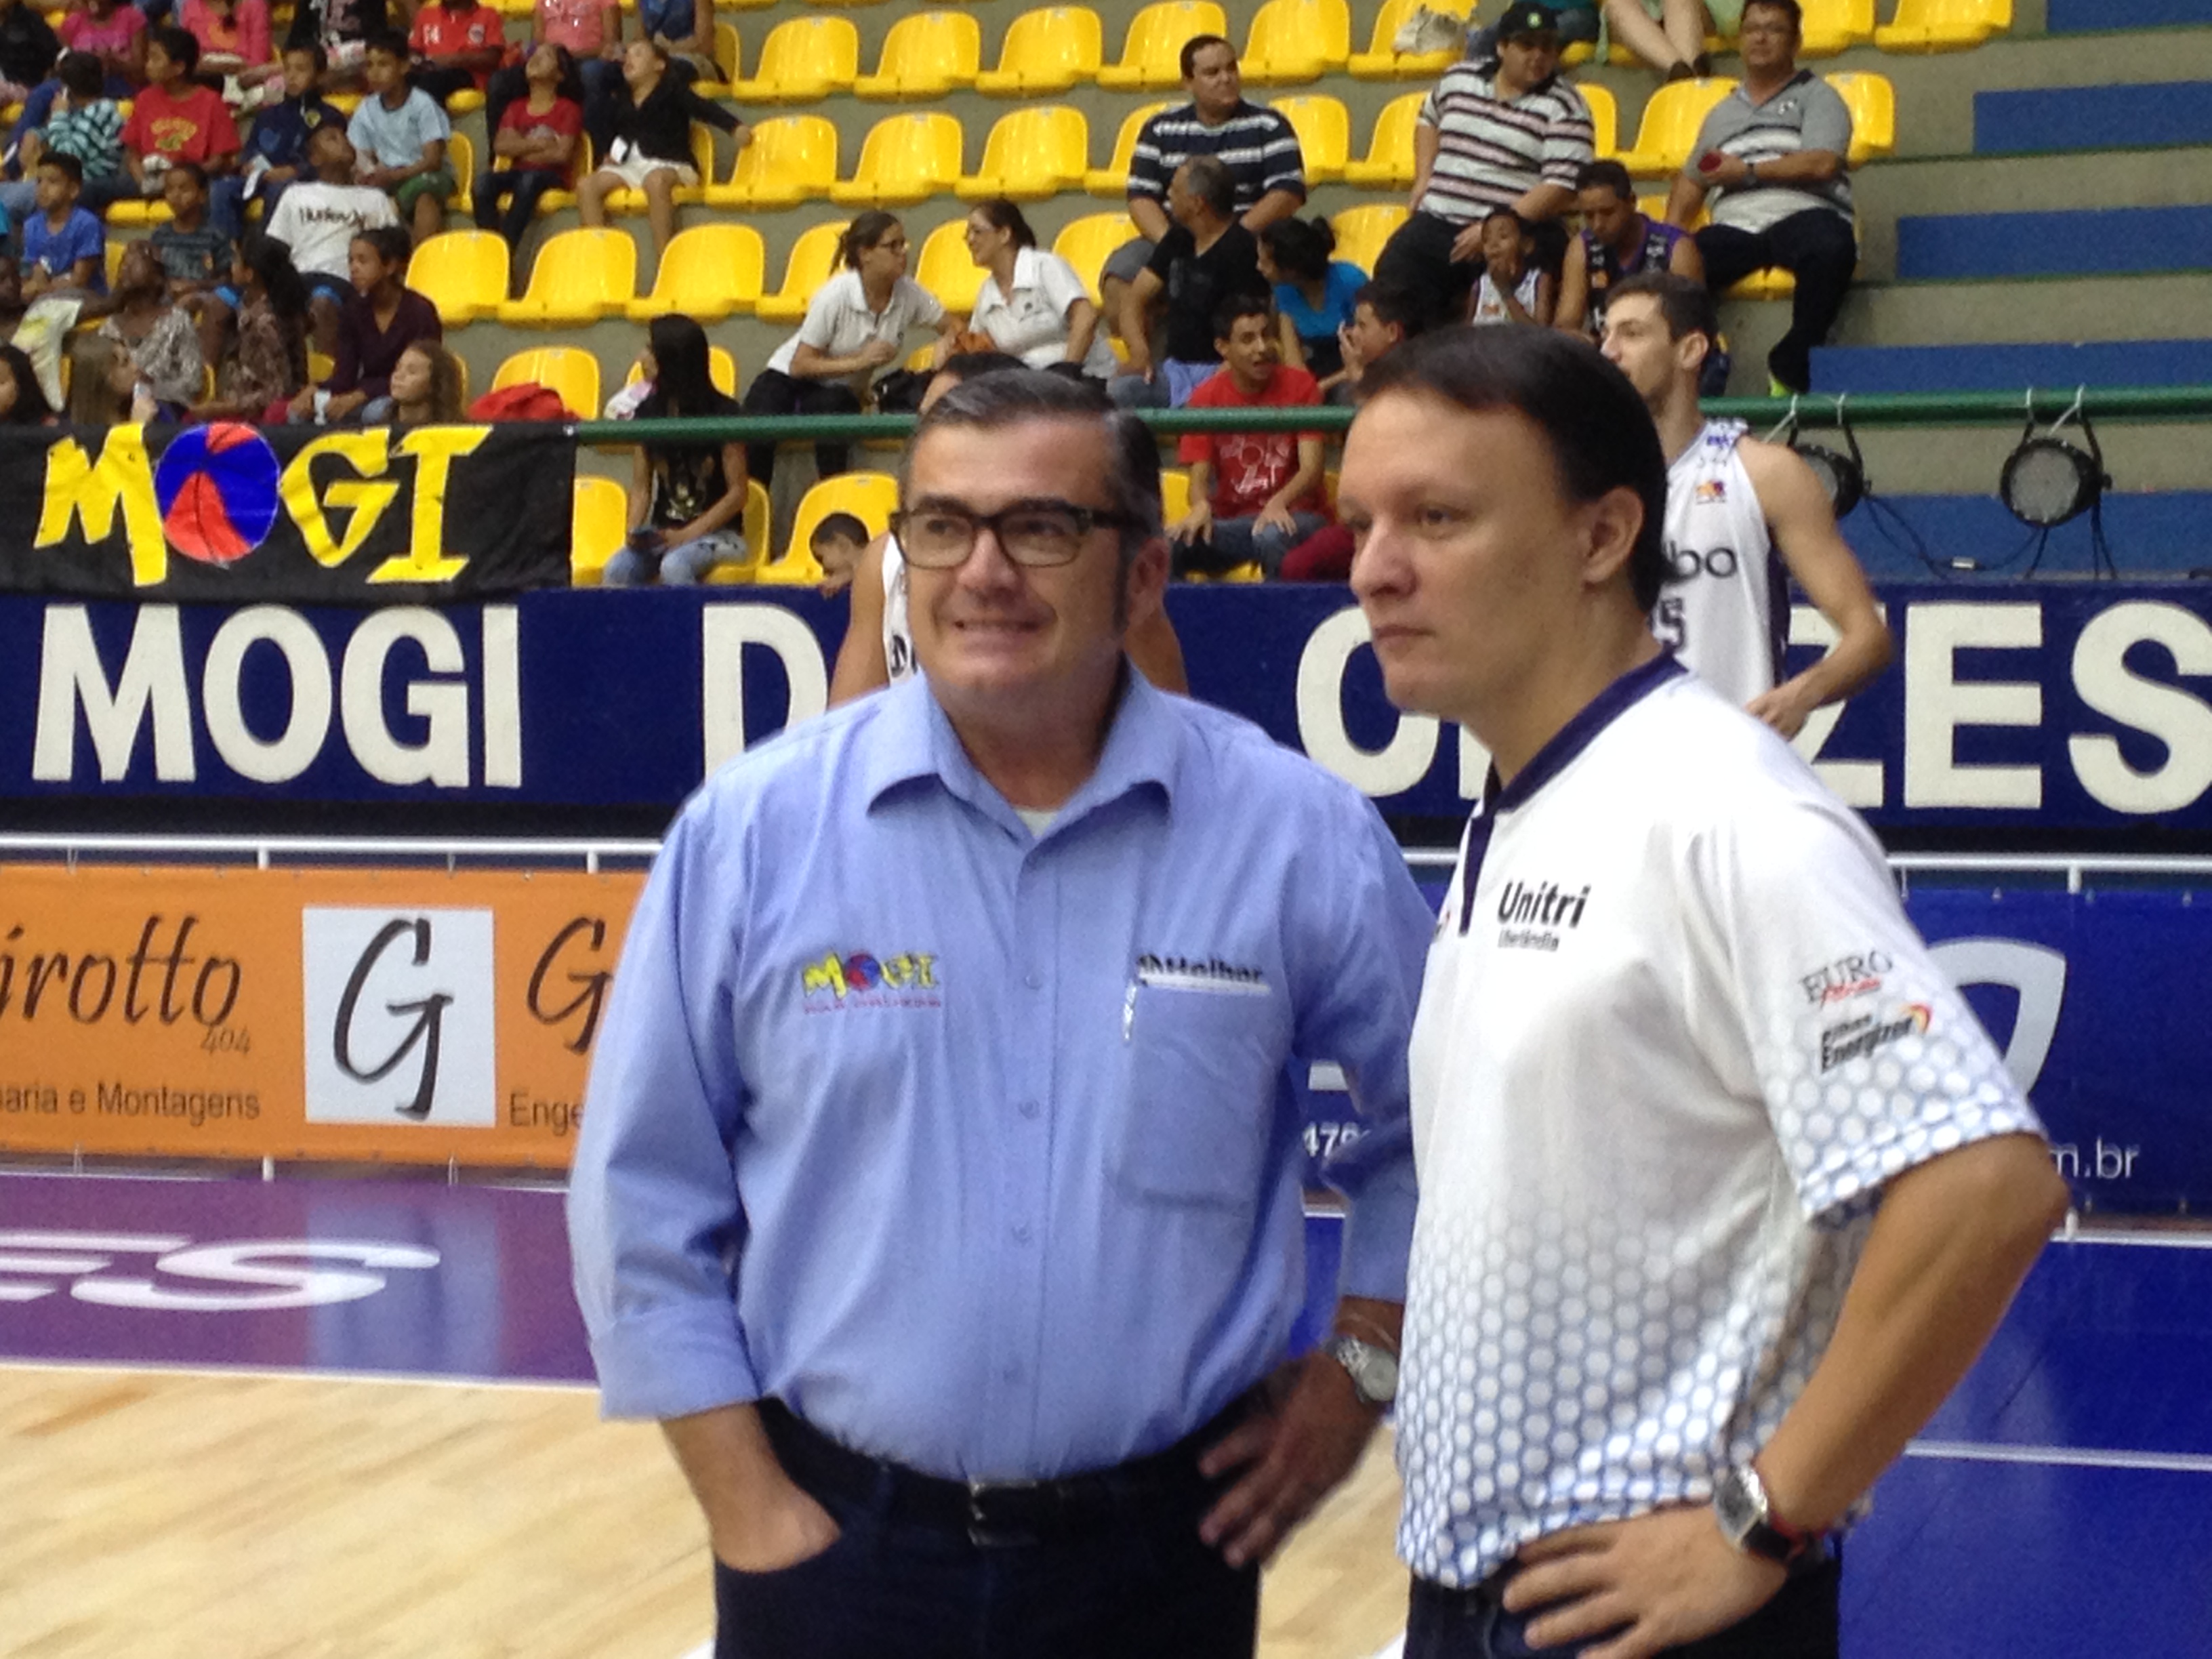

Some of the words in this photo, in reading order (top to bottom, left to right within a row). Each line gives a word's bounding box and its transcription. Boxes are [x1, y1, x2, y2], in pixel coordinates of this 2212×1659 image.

[34, 421, 494, 587] MOGI
[32, 602, 522, 789] MOGI
[1296, 600, 2212, 815] CZES
[1497, 880, 1591, 929] Unitri
[333, 916, 453, 1121] G
[0, 1083, 58, 1115] aria
[69, 1089, 85, 1115] e
[98, 1080, 260, 1127] Montagens
